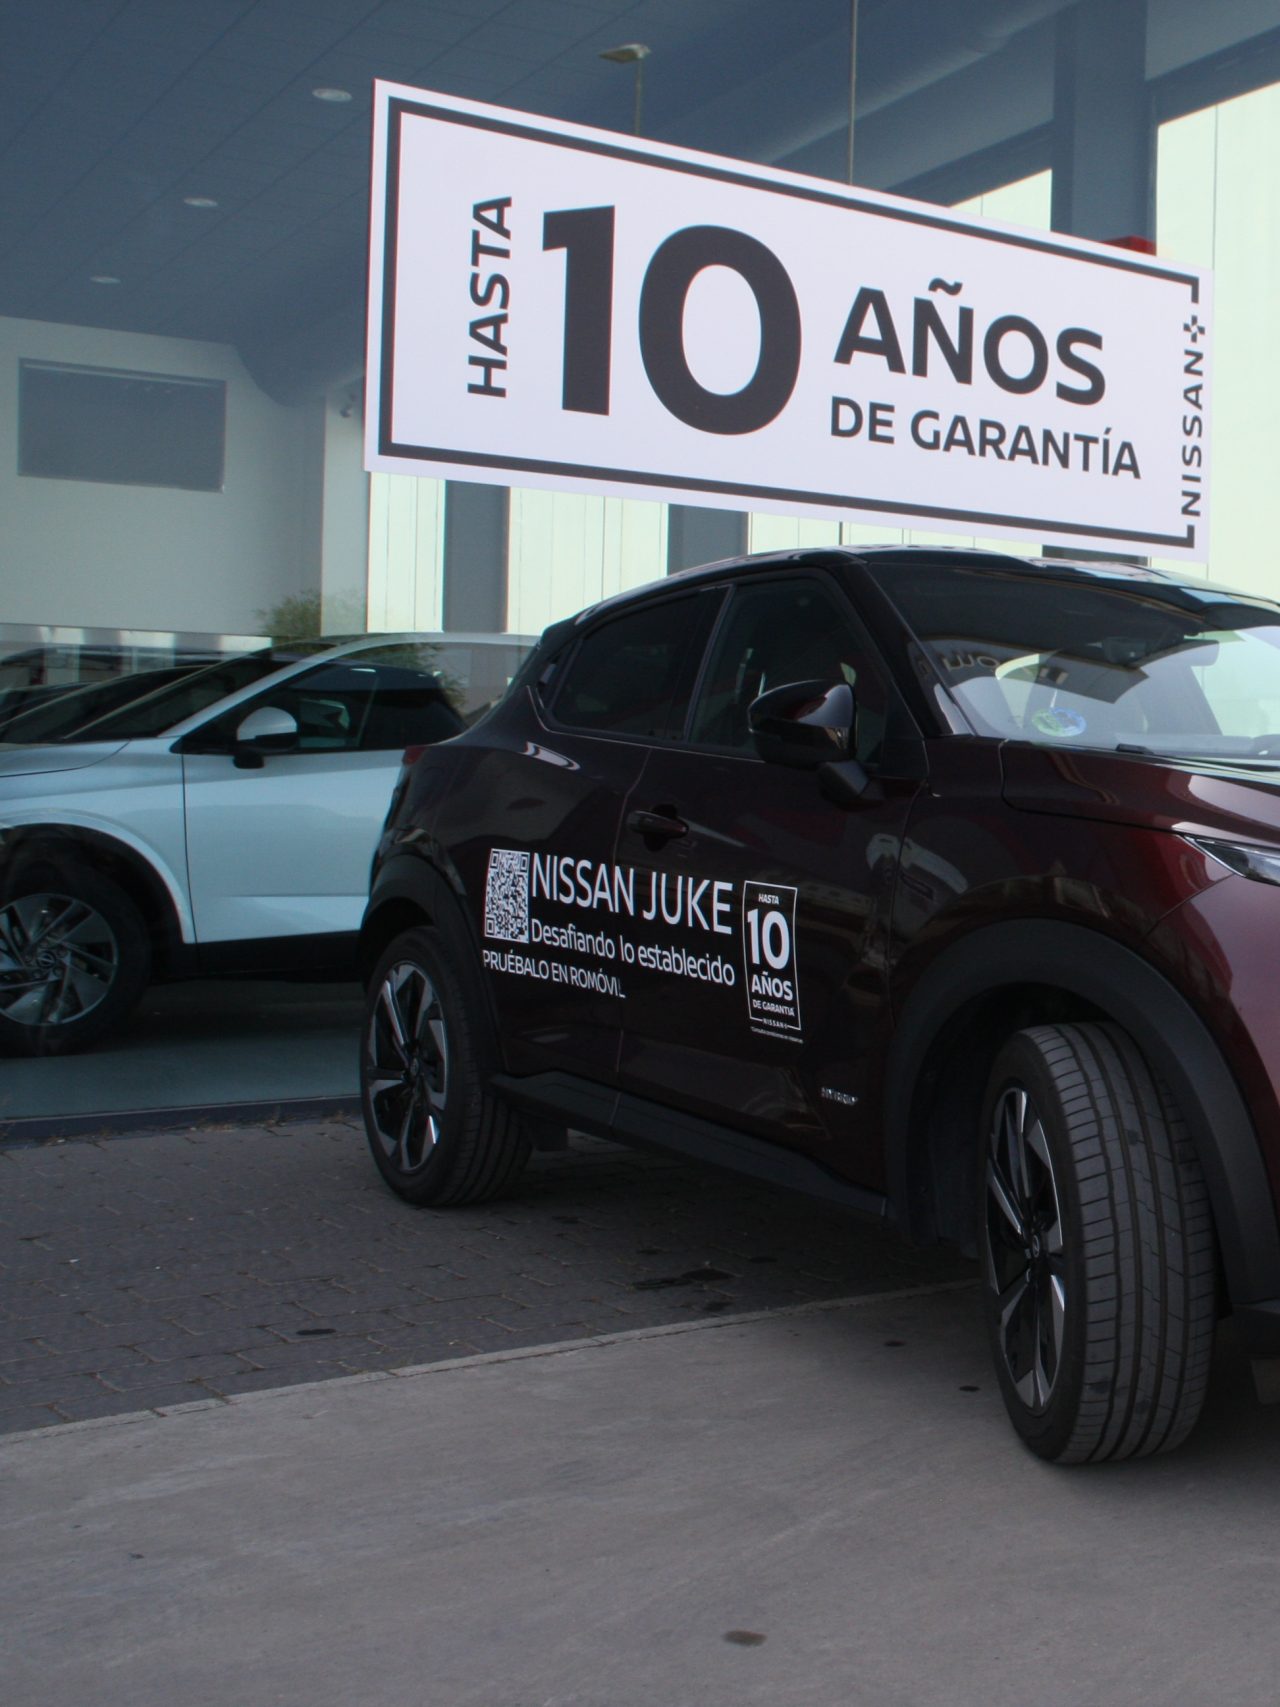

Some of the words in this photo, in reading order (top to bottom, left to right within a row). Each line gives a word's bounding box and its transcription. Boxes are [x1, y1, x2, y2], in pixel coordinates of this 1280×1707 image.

[467, 196, 512, 398] HASTA
[542, 205, 802, 436] 10
[833, 278, 1106, 405] AÑOS
[830, 396, 894, 443] DE
[910, 410, 1142, 480] GARANTÍA
[1181, 349, 1204, 517] NISSAN
[532, 852, 635, 917] NISSAN
[642, 871, 734, 935] JUKE
[758, 893, 780, 906] HASTA
[483, 949, 549, 980] PRUÉBALO
[552, 964, 569, 985] EN
[571, 967, 626, 999] ROMÓVIL
[532, 918, 615, 960] Desafiando
[620, 935, 635, 964] lo
[638, 942, 735, 986] establecido
[747, 908, 790, 970] 10
[751, 970, 794, 1001] AÑOS
[752, 999, 762, 1009] DE
